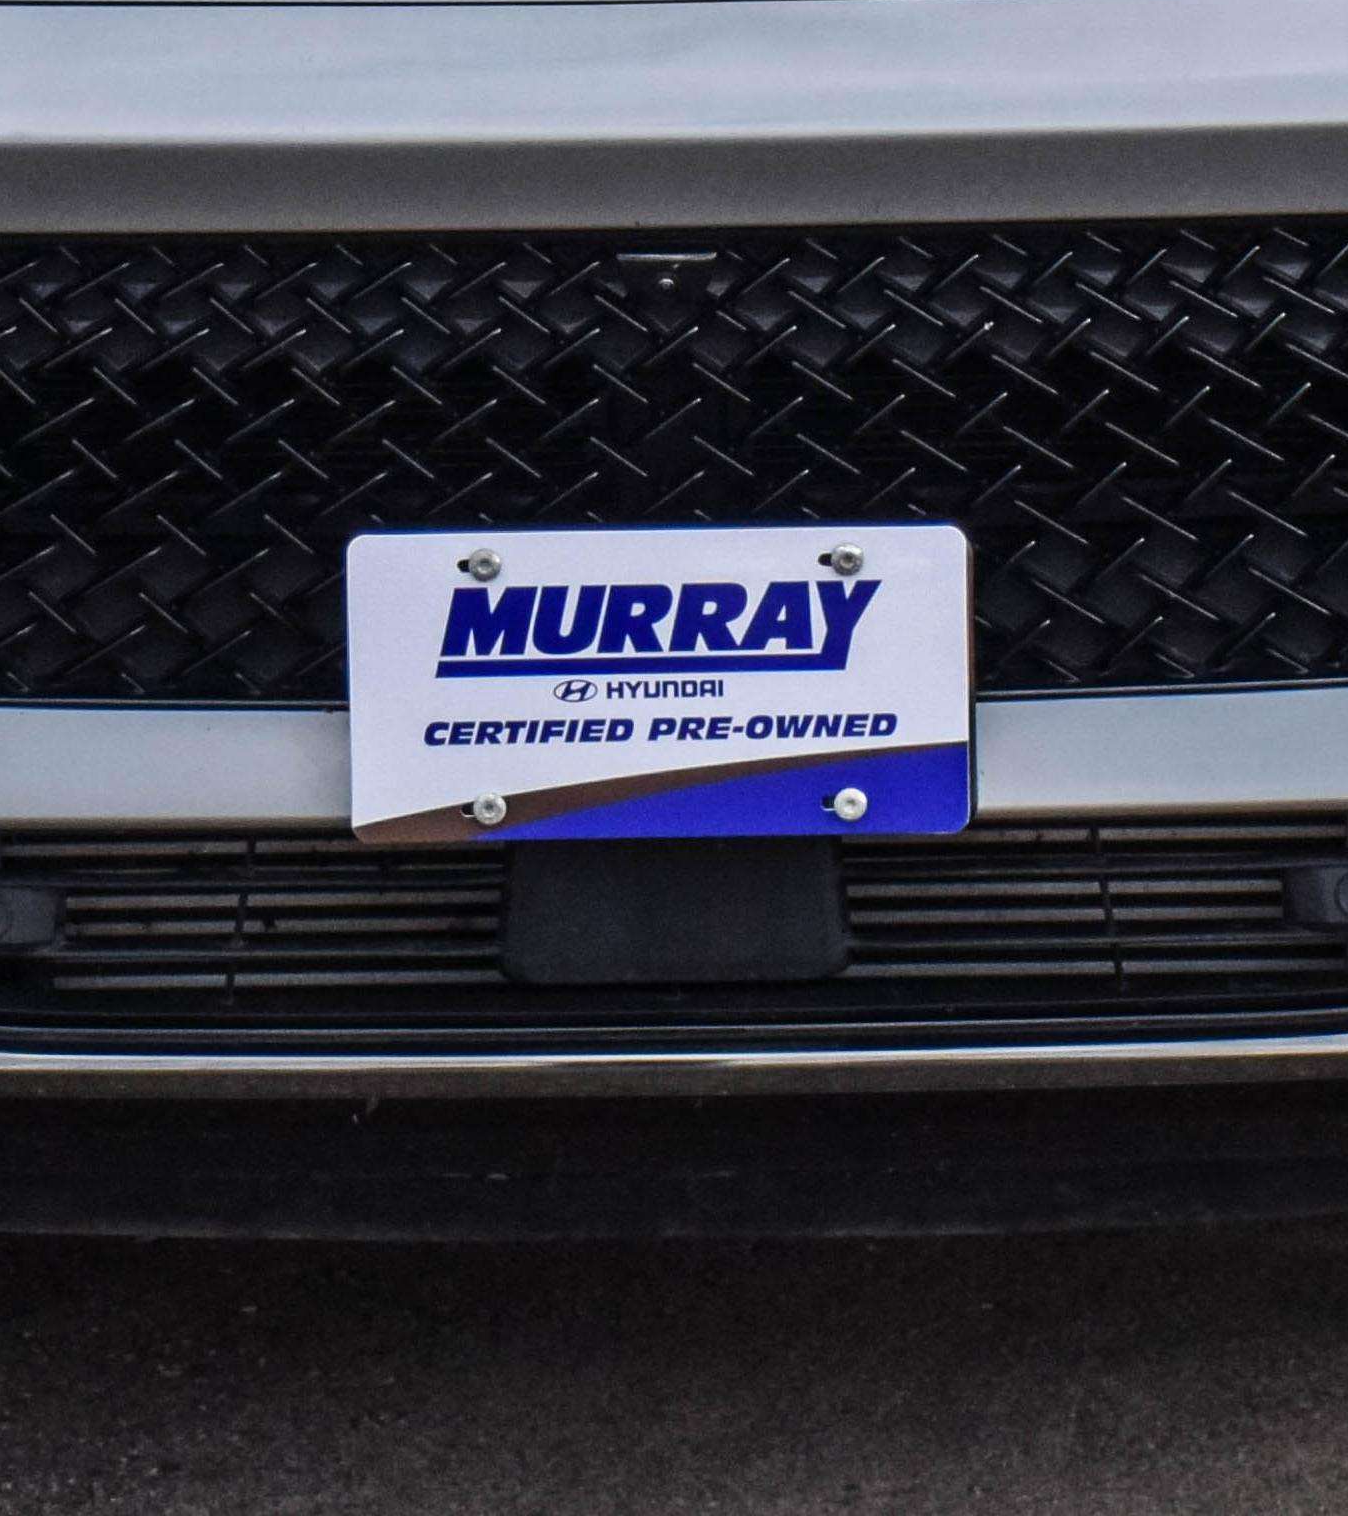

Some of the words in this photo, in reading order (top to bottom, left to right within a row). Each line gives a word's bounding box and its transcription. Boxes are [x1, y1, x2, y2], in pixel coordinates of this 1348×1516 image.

[439, 579, 882, 660] MURRAY
[605, 678, 724, 700] HYUNDAI
[424, 717, 633, 747] CERTIFIED
[648, 712, 898, 742] PRE-OWNED
